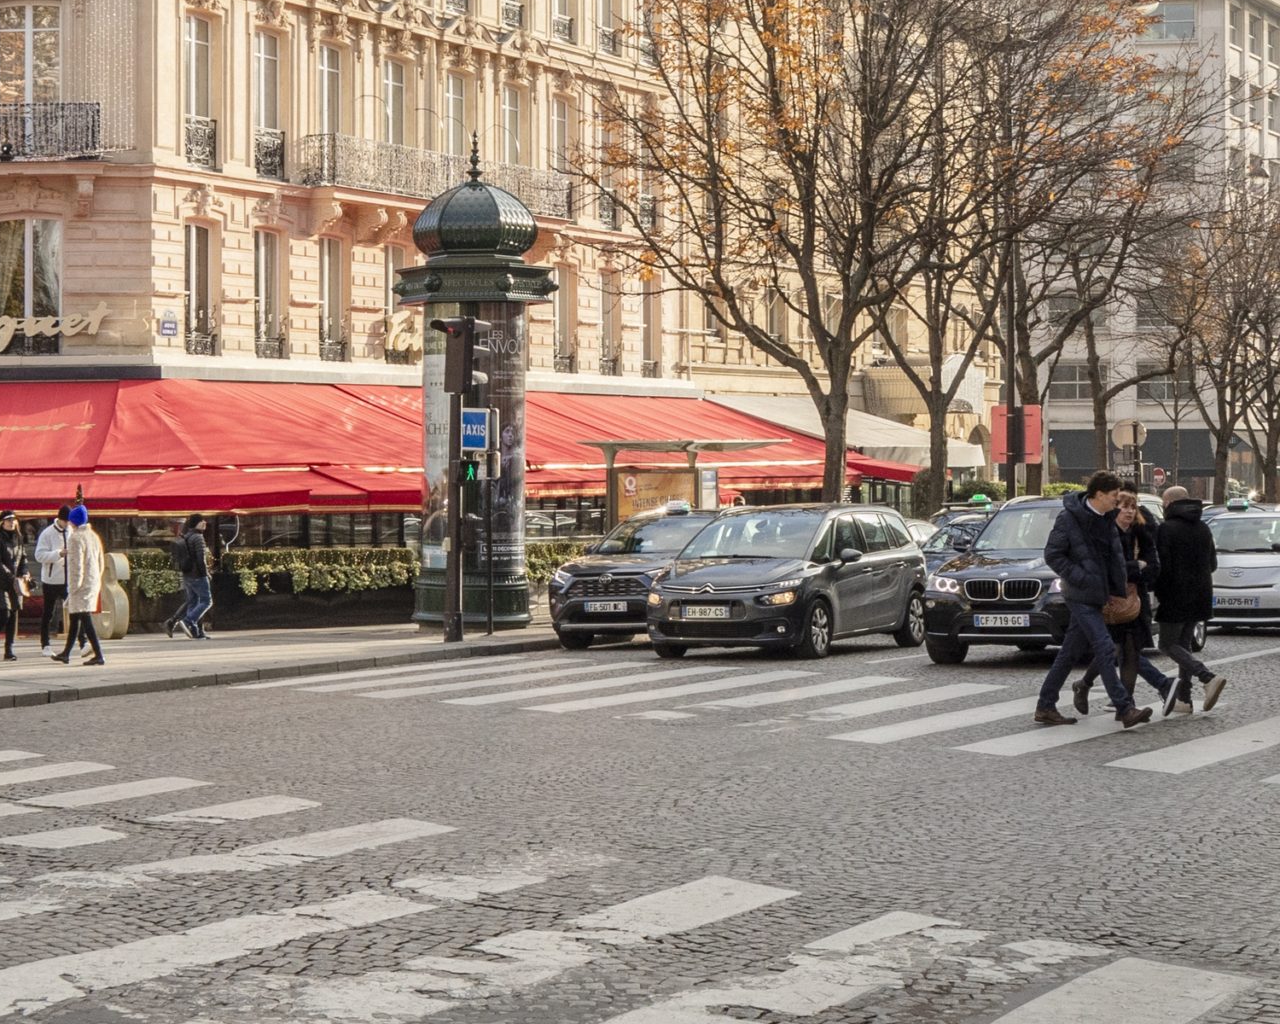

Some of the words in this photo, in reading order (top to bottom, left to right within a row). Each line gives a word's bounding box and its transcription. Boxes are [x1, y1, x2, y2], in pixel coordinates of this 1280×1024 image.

[443, 278, 495, 287] SPECTACLES
[488, 330, 503, 339] LES
[462, 424, 486, 436] TAXIS
